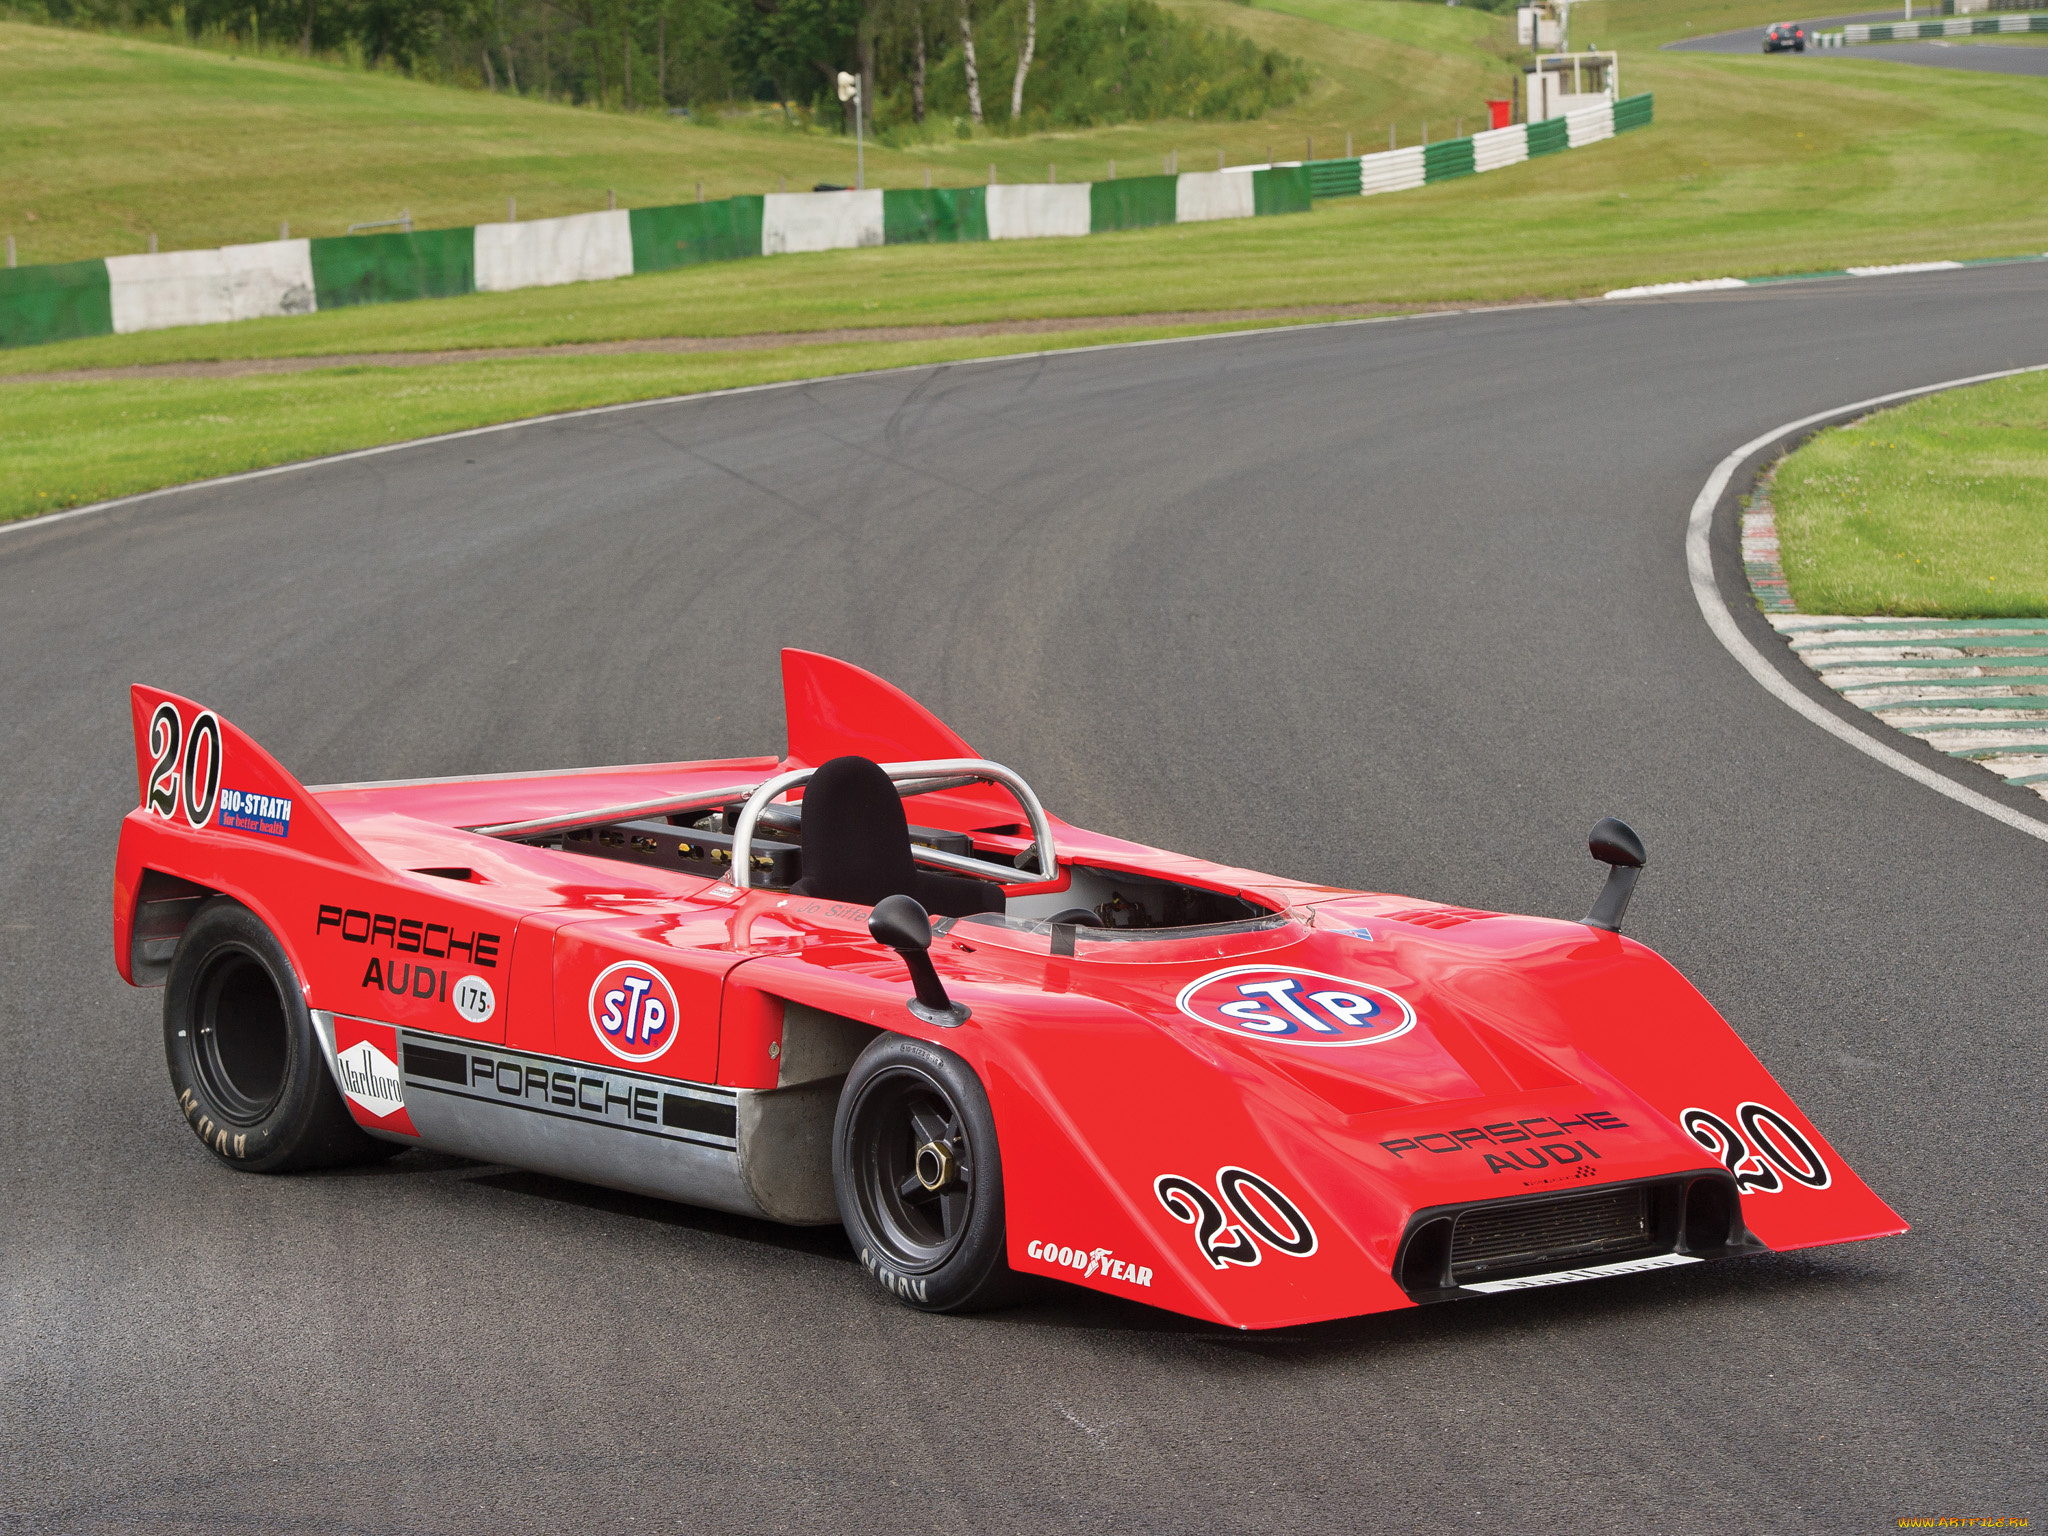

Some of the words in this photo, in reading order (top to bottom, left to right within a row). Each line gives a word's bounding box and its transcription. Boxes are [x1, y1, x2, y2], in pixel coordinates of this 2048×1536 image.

[144, 701, 223, 829] 20
[220, 788, 292, 821] BIO-STRATH
[223, 811, 235, 826] for
[235, 814, 259, 831] better
[259, 818, 284, 836] health
[797, 902, 820, 914] Jo
[316, 904, 501, 968] PORSCHE
[361, 957, 447, 1003] AUDI
[461, 985, 487, 1013] 175
[1217, 978, 1382, 1035] STP
[601, 975, 667, 1046] STP
[338, 1048, 403, 1103] Marlboro
[471, 1055, 659, 1125] PORSCHE
[1379, 1111, 1630, 1159] PORSCHE
[1482, 1140, 1602, 1175] AUDI
[1680, 1101, 1832, 1195] 20
[1153, 1165, 1319, 1270] 20
